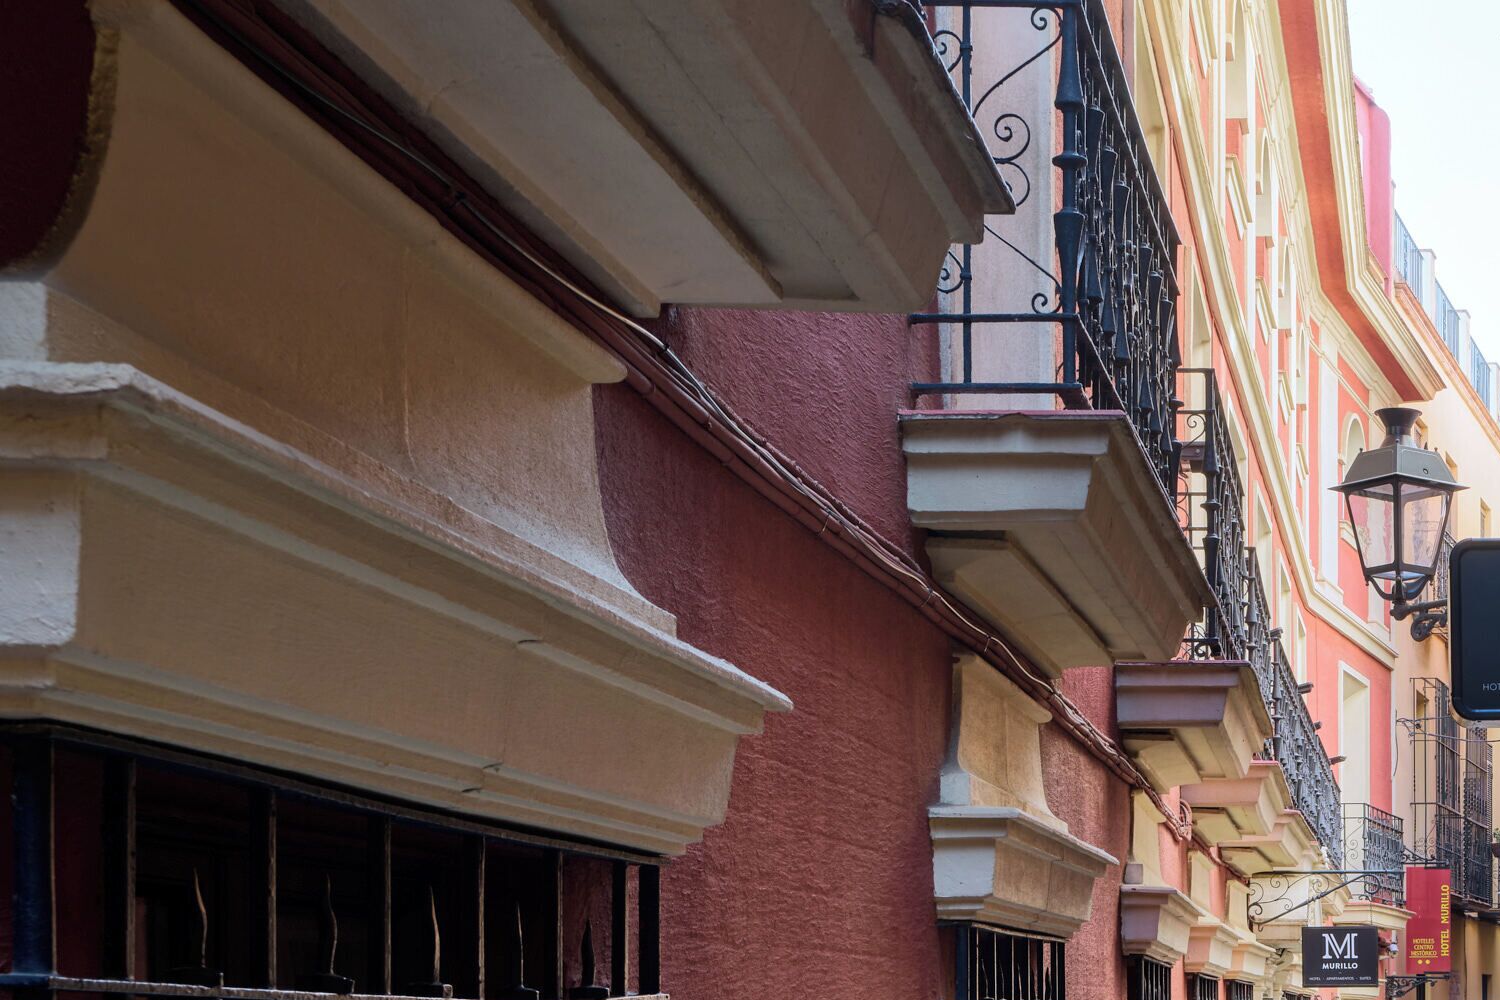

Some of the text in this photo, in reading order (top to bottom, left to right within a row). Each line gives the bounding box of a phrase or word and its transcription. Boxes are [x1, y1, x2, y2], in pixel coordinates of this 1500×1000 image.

[1441, 884, 1449, 956] HOTEL MURILLO
[1322, 933, 1358, 959] M
